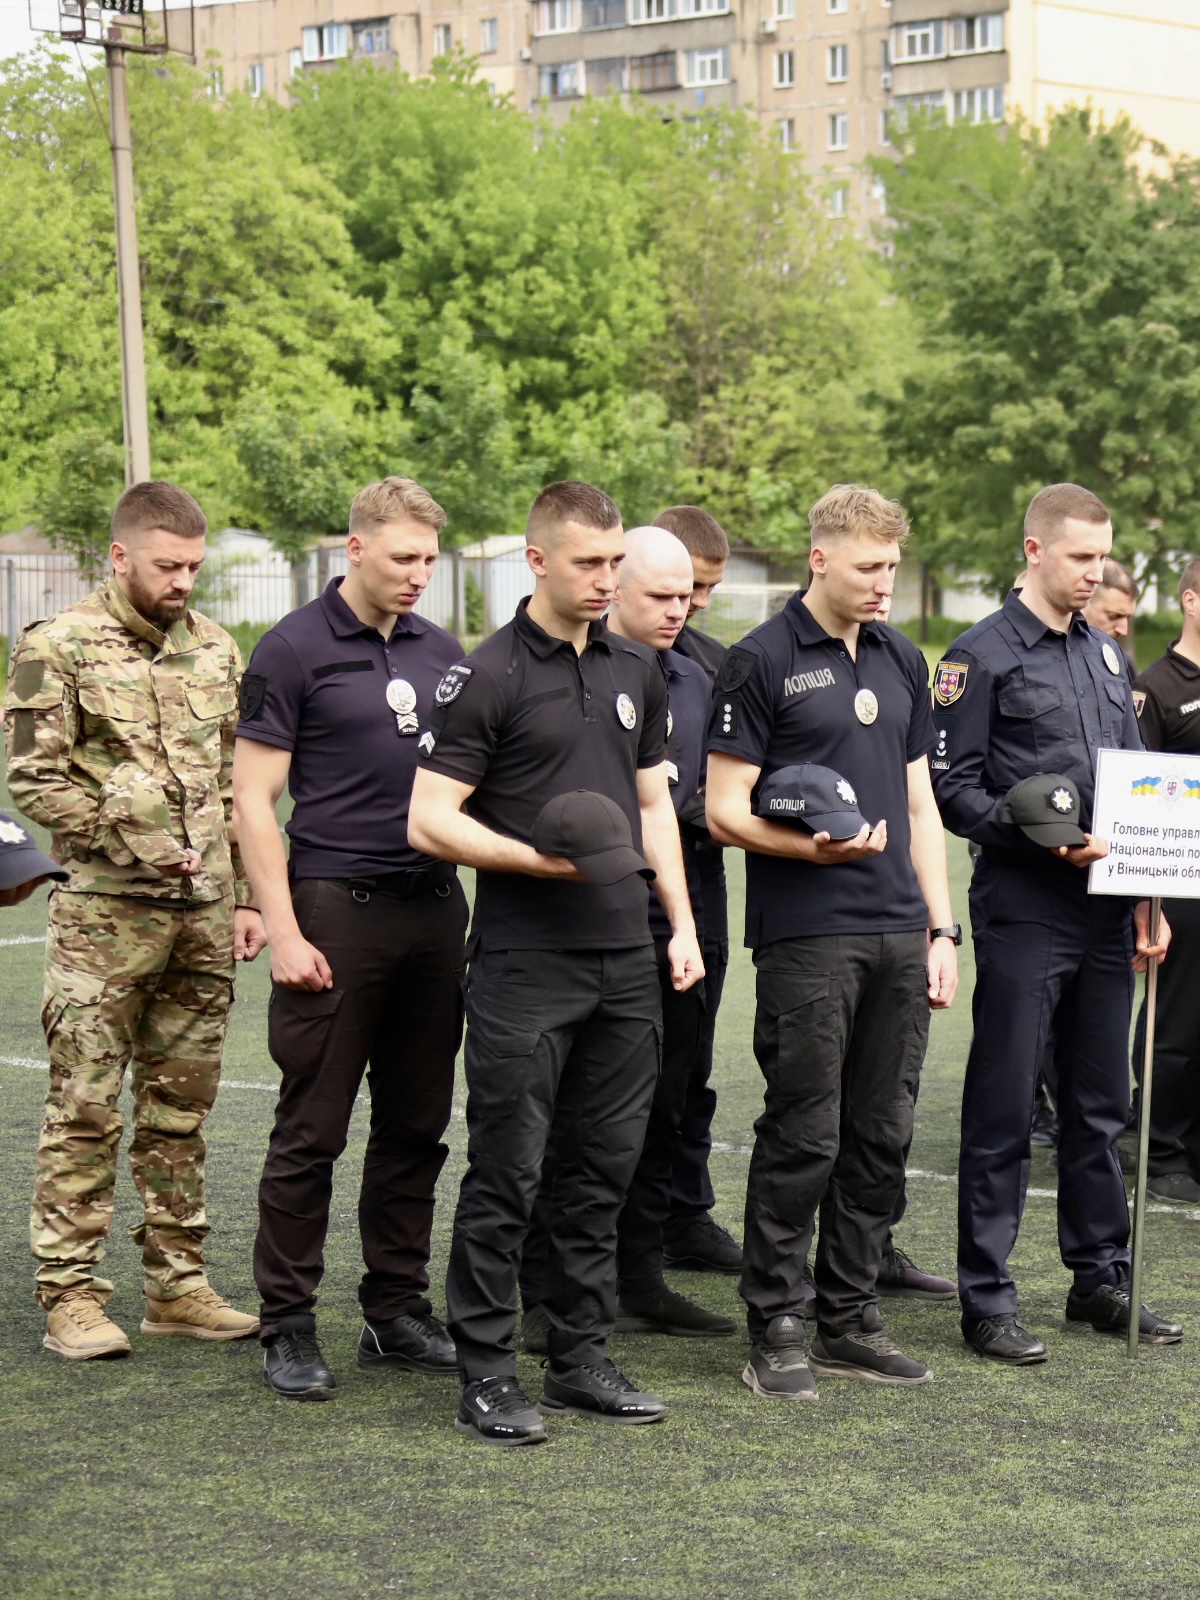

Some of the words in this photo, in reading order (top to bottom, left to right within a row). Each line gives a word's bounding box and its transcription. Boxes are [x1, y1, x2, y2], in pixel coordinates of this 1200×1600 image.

[785, 667, 836, 697] ПОЛІЦІЯ
[770, 798, 806, 811] ПОЛІЦІЯ
[1113, 821, 1159, 837] Головне
[1109, 842, 1185, 858] Національної
[1107, 864, 1114, 878] у
[1117, 862, 1179, 879] Вінницькій
